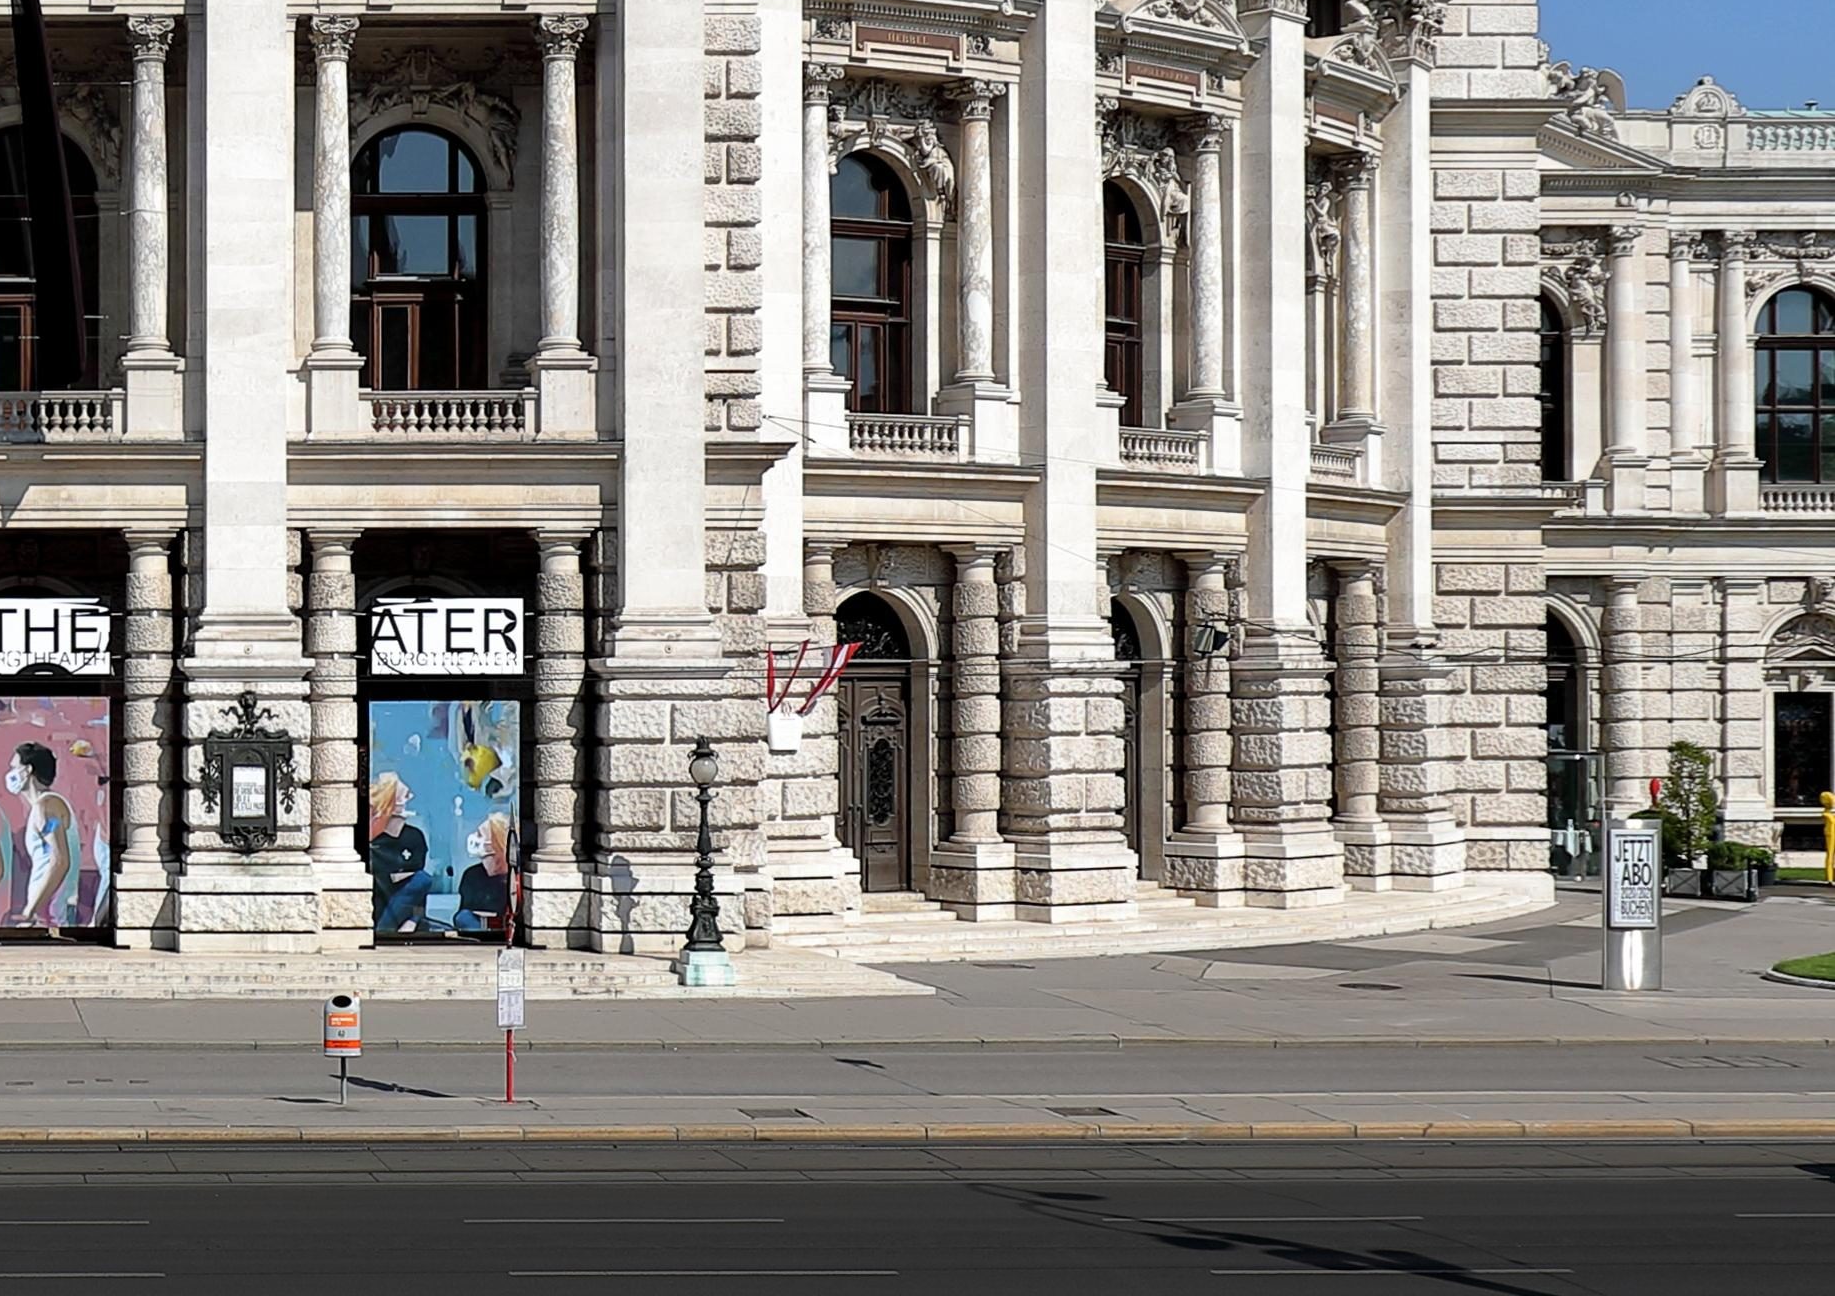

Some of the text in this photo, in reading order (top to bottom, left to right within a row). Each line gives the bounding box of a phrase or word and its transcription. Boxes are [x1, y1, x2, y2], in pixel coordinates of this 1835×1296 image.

[372, 608, 518, 653] ATER
[377, 651, 518, 667] BURGTHEATER
[1614, 839, 1653, 862] JETZT
[1620, 863, 1652, 886] ABO
